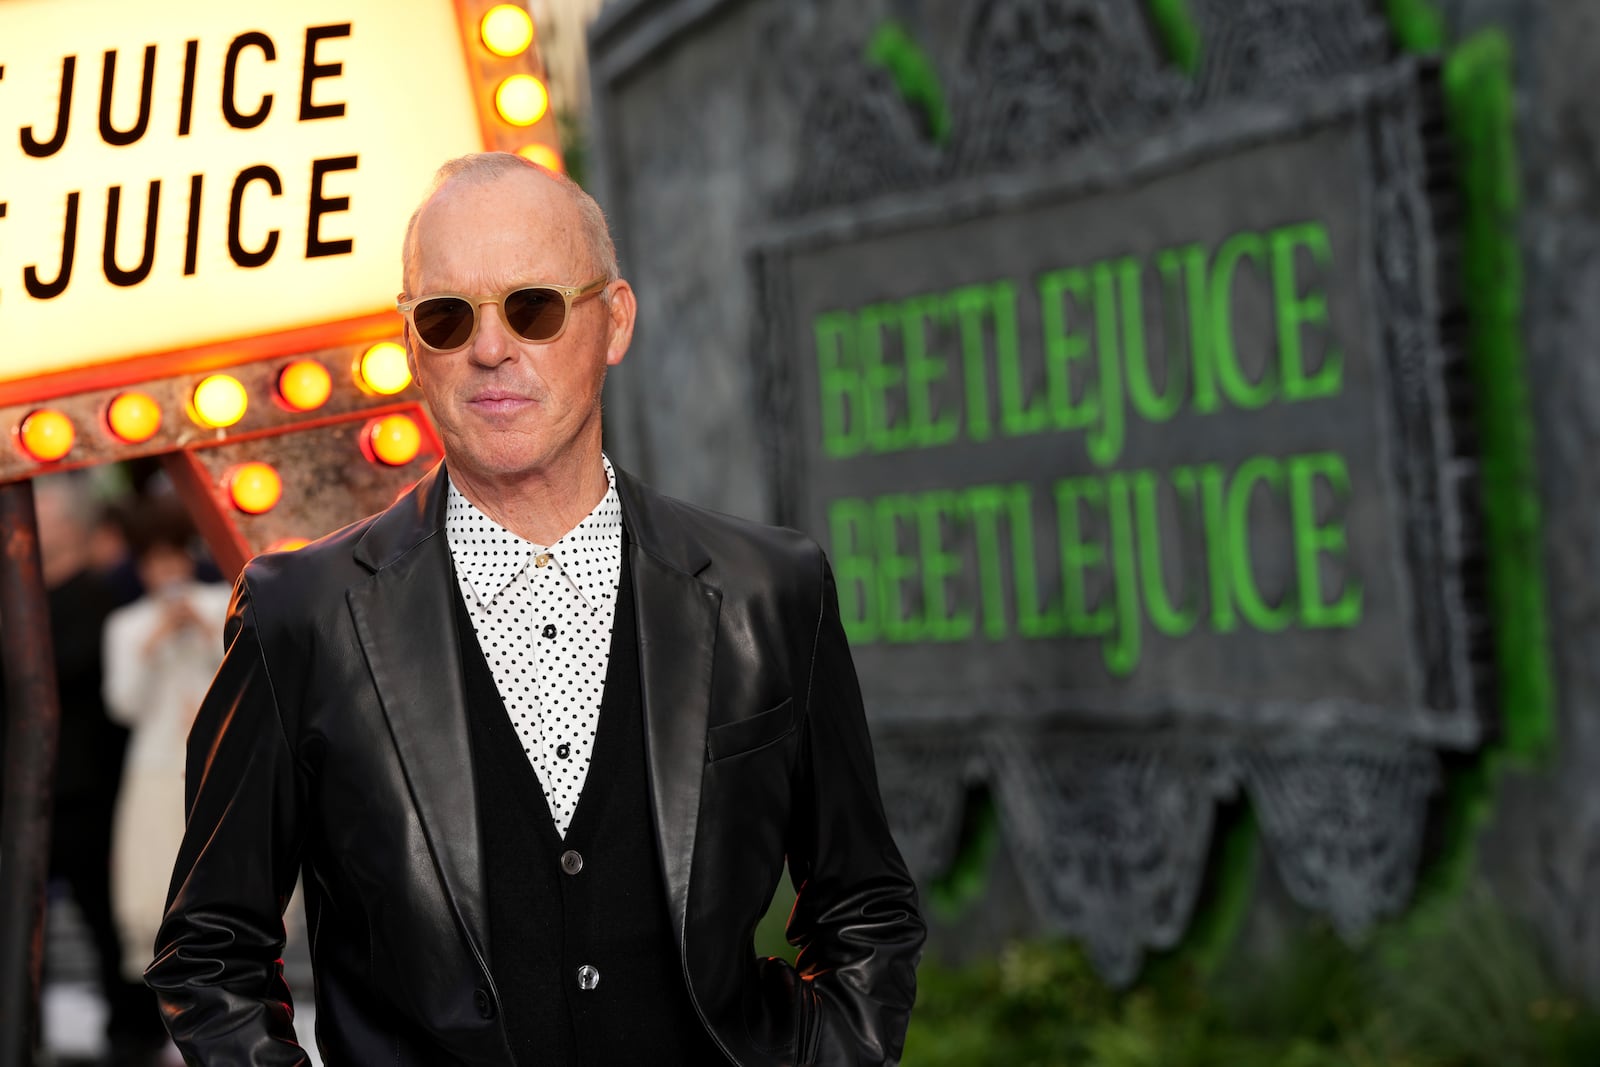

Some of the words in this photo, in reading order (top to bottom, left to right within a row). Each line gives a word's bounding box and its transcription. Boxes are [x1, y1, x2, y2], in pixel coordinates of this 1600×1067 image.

[0, 23, 352, 158] JUICE
[0, 155, 358, 300] JUICE
[815, 222, 1343, 466] BEETLEJUICE
[829, 453, 1363, 675] BEETLEJUICE
